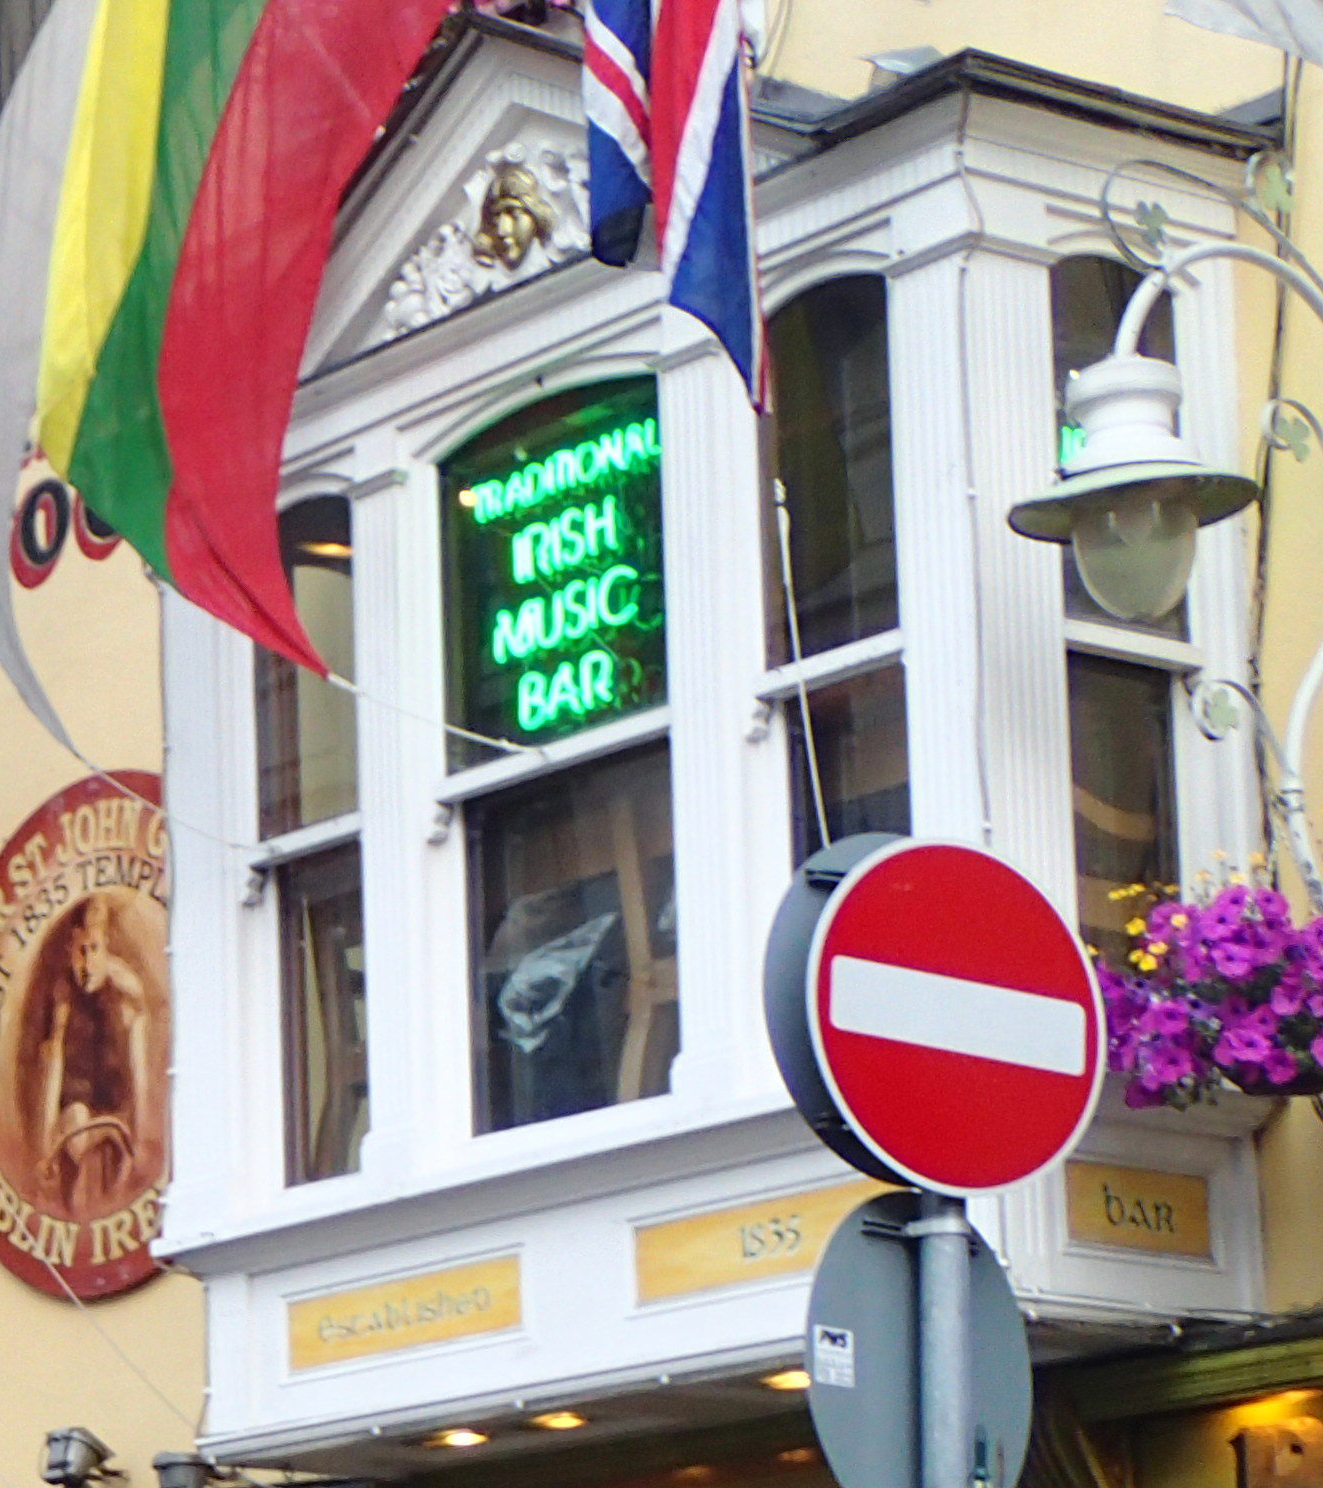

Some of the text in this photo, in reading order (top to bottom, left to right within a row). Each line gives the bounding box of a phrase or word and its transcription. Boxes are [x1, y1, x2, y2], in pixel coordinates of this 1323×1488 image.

[470, 416, 662, 524] TRADITIONAL
[511, 494, 620, 584] IRISH
[492, 563, 640, 664] MUSIC
[516, 649, 615, 731] BAR
[8, 830, 50, 900] ST
[56, 798, 143, 864] JOHN
[10, 872, 70, 949] 1835
[76, 854, 169, 909] TEMPL
[90, 1180, 167, 1265] IRE
